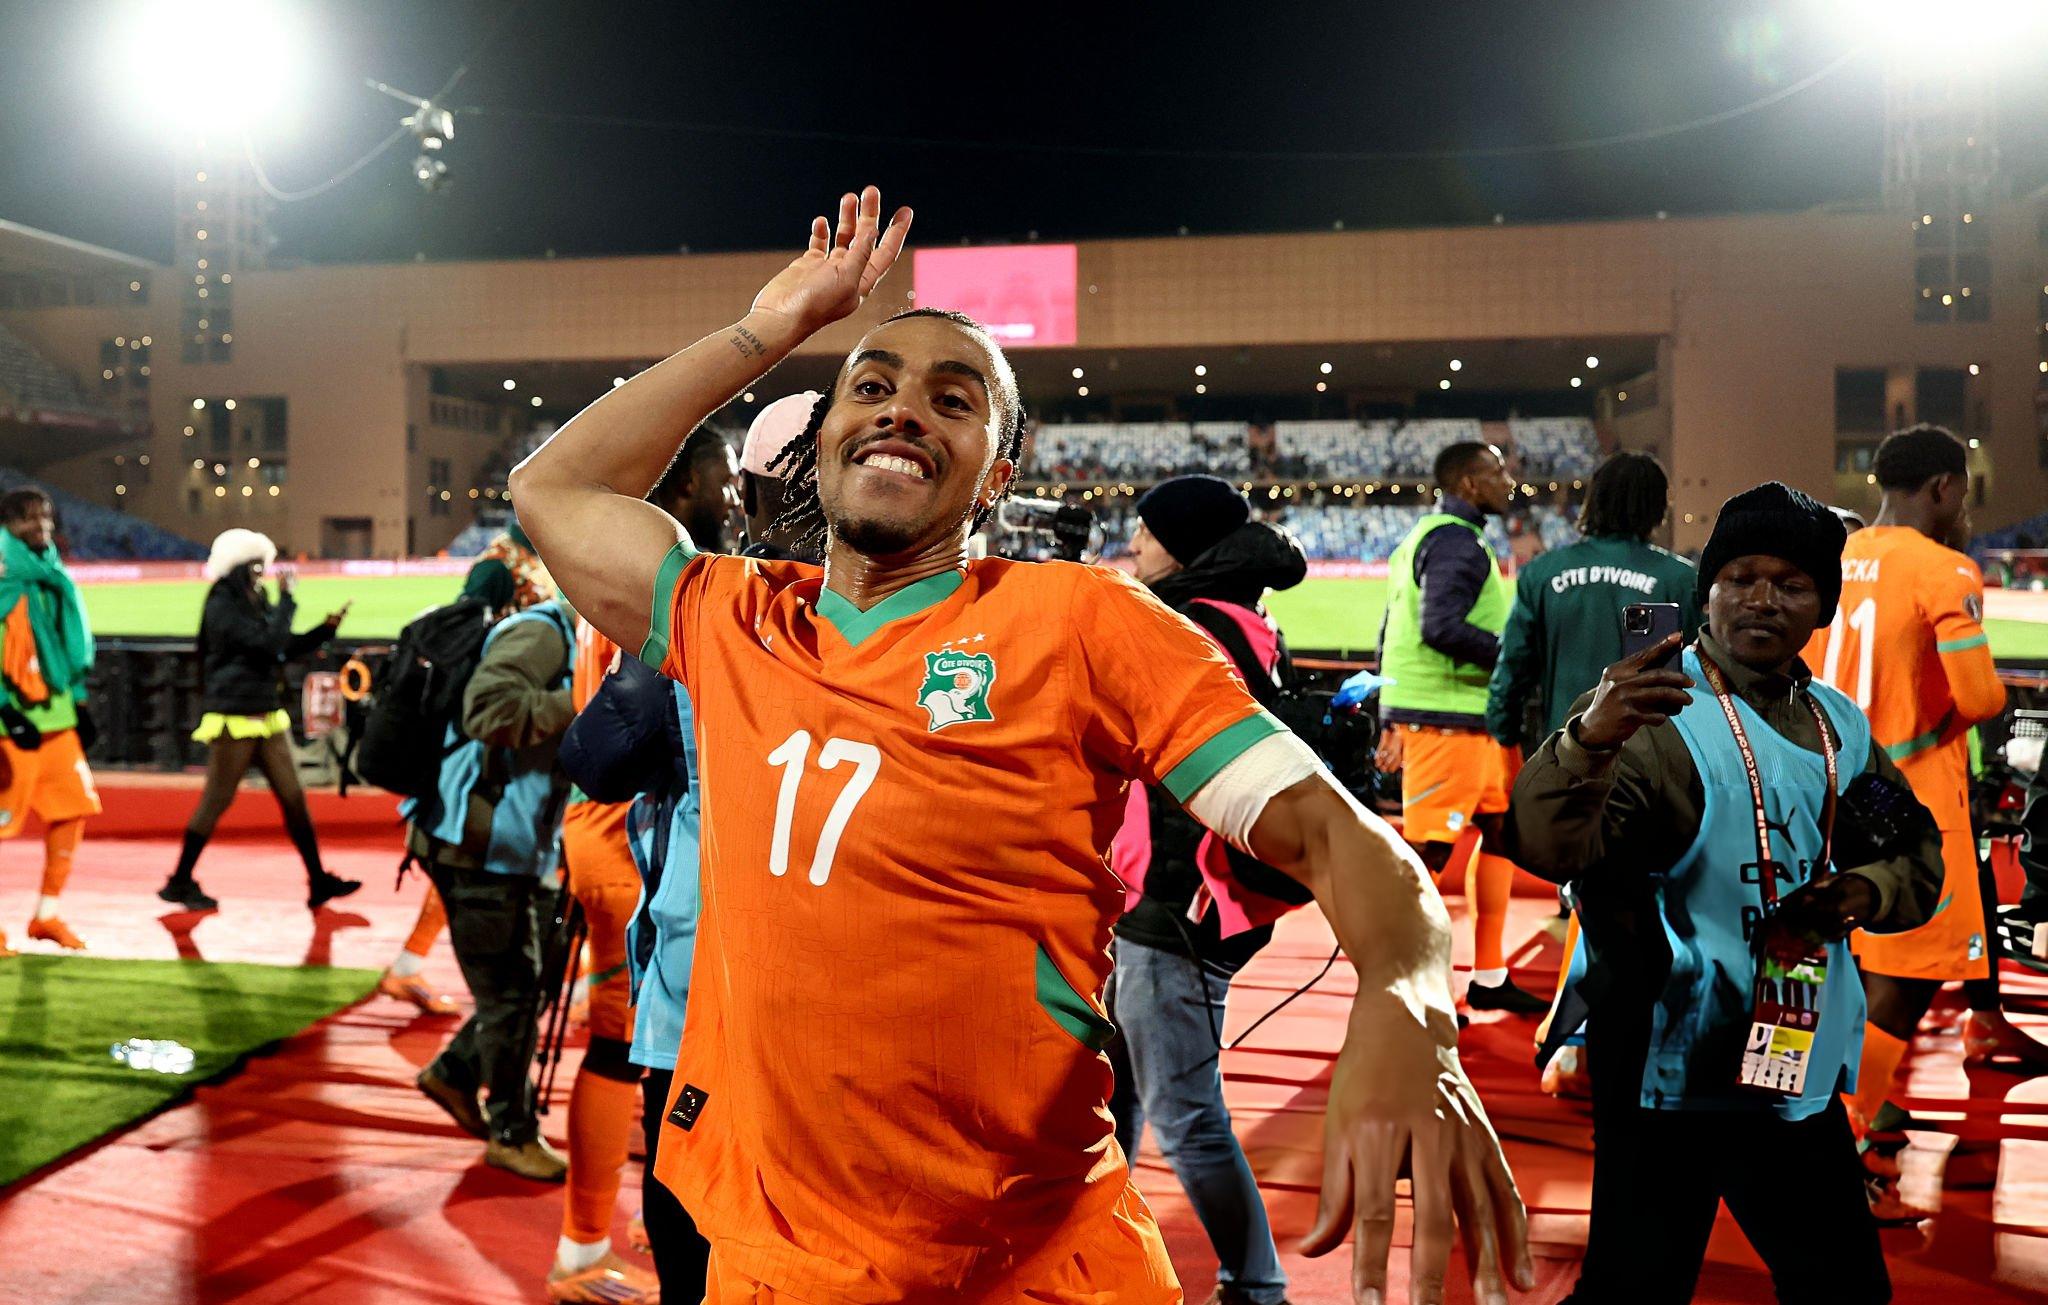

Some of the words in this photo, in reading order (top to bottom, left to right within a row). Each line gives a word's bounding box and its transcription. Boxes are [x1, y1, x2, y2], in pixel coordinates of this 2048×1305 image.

[730, 336, 753, 359] LOVE
[1719, 694, 1743, 734] NATIONS
[1736, 734, 1748, 748] OF
[1743, 748, 1755, 769] CUP
[767, 729, 882, 887] 17
